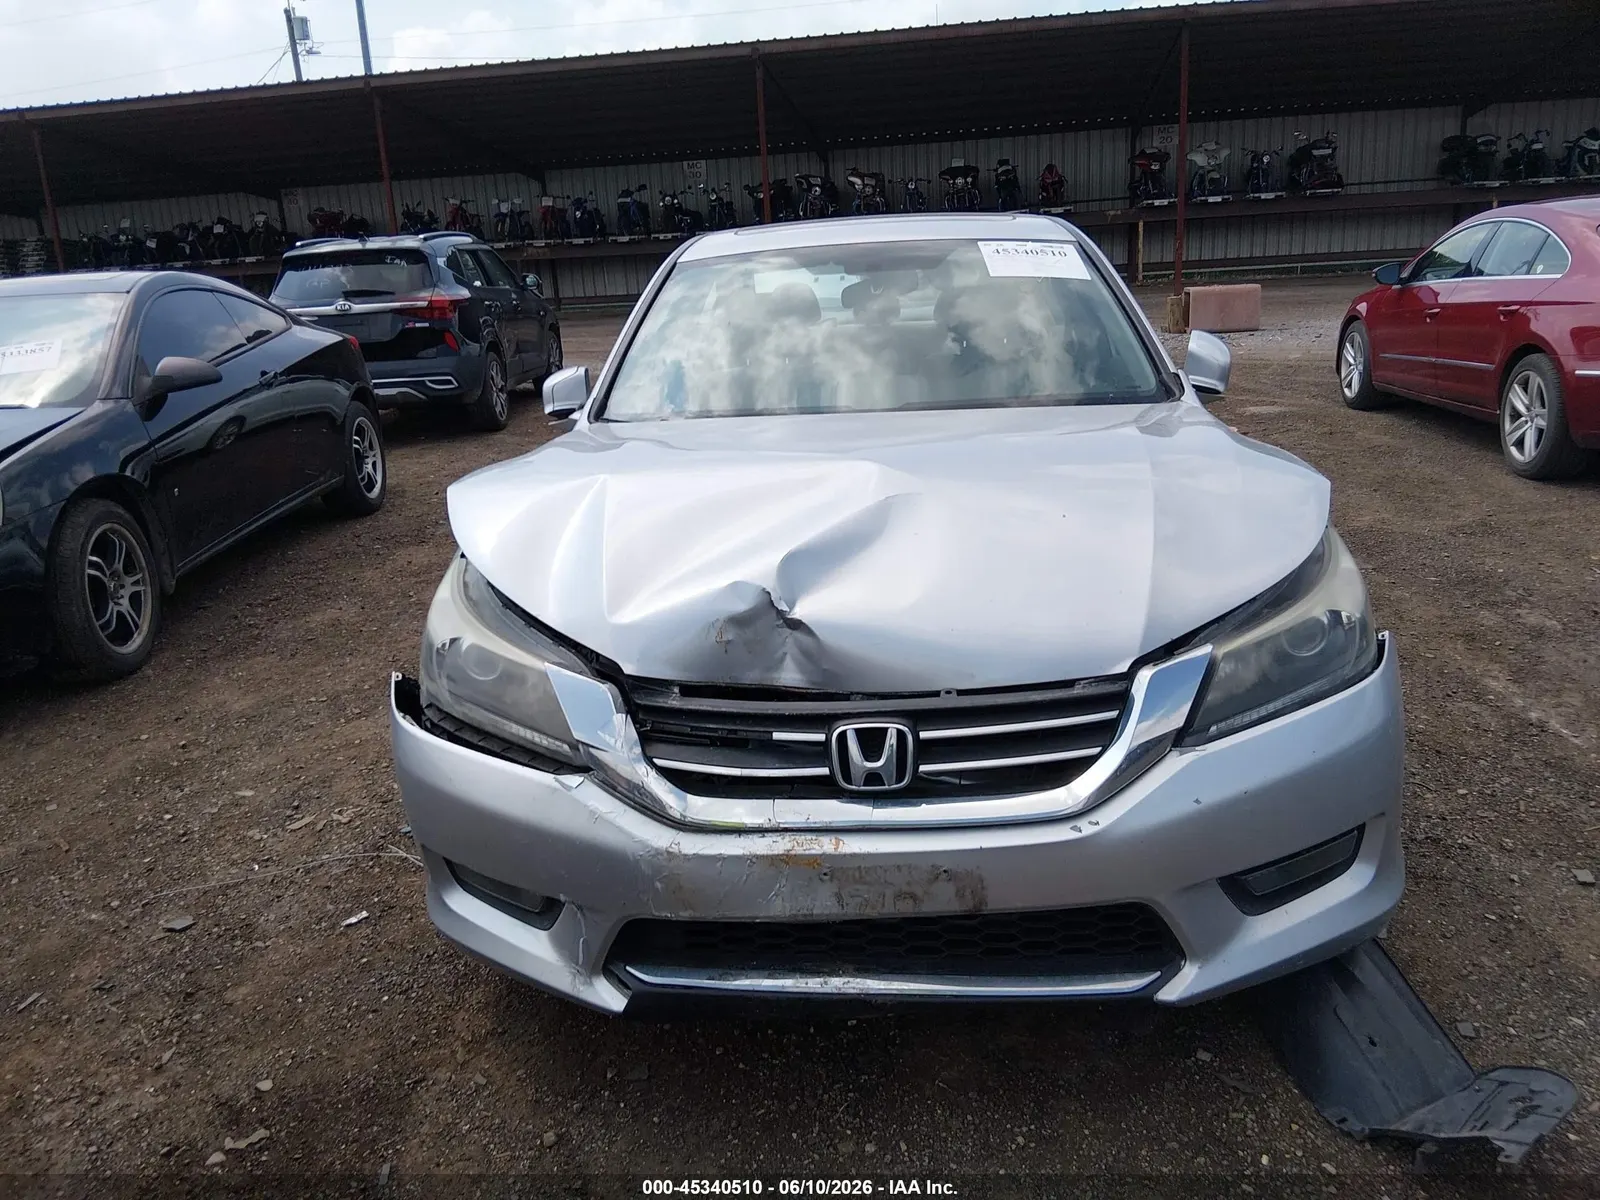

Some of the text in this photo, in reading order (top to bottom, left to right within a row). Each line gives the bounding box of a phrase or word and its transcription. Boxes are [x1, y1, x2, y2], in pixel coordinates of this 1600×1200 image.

[1156, 126, 1175, 134] MC
[1159, 136, 1173, 144] 20
[687, 161, 702, 169] MC
[688, 170, 702, 179] 30
[992, 248, 1068, 258] 45340510
[336, 303, 351, 311] KIA
